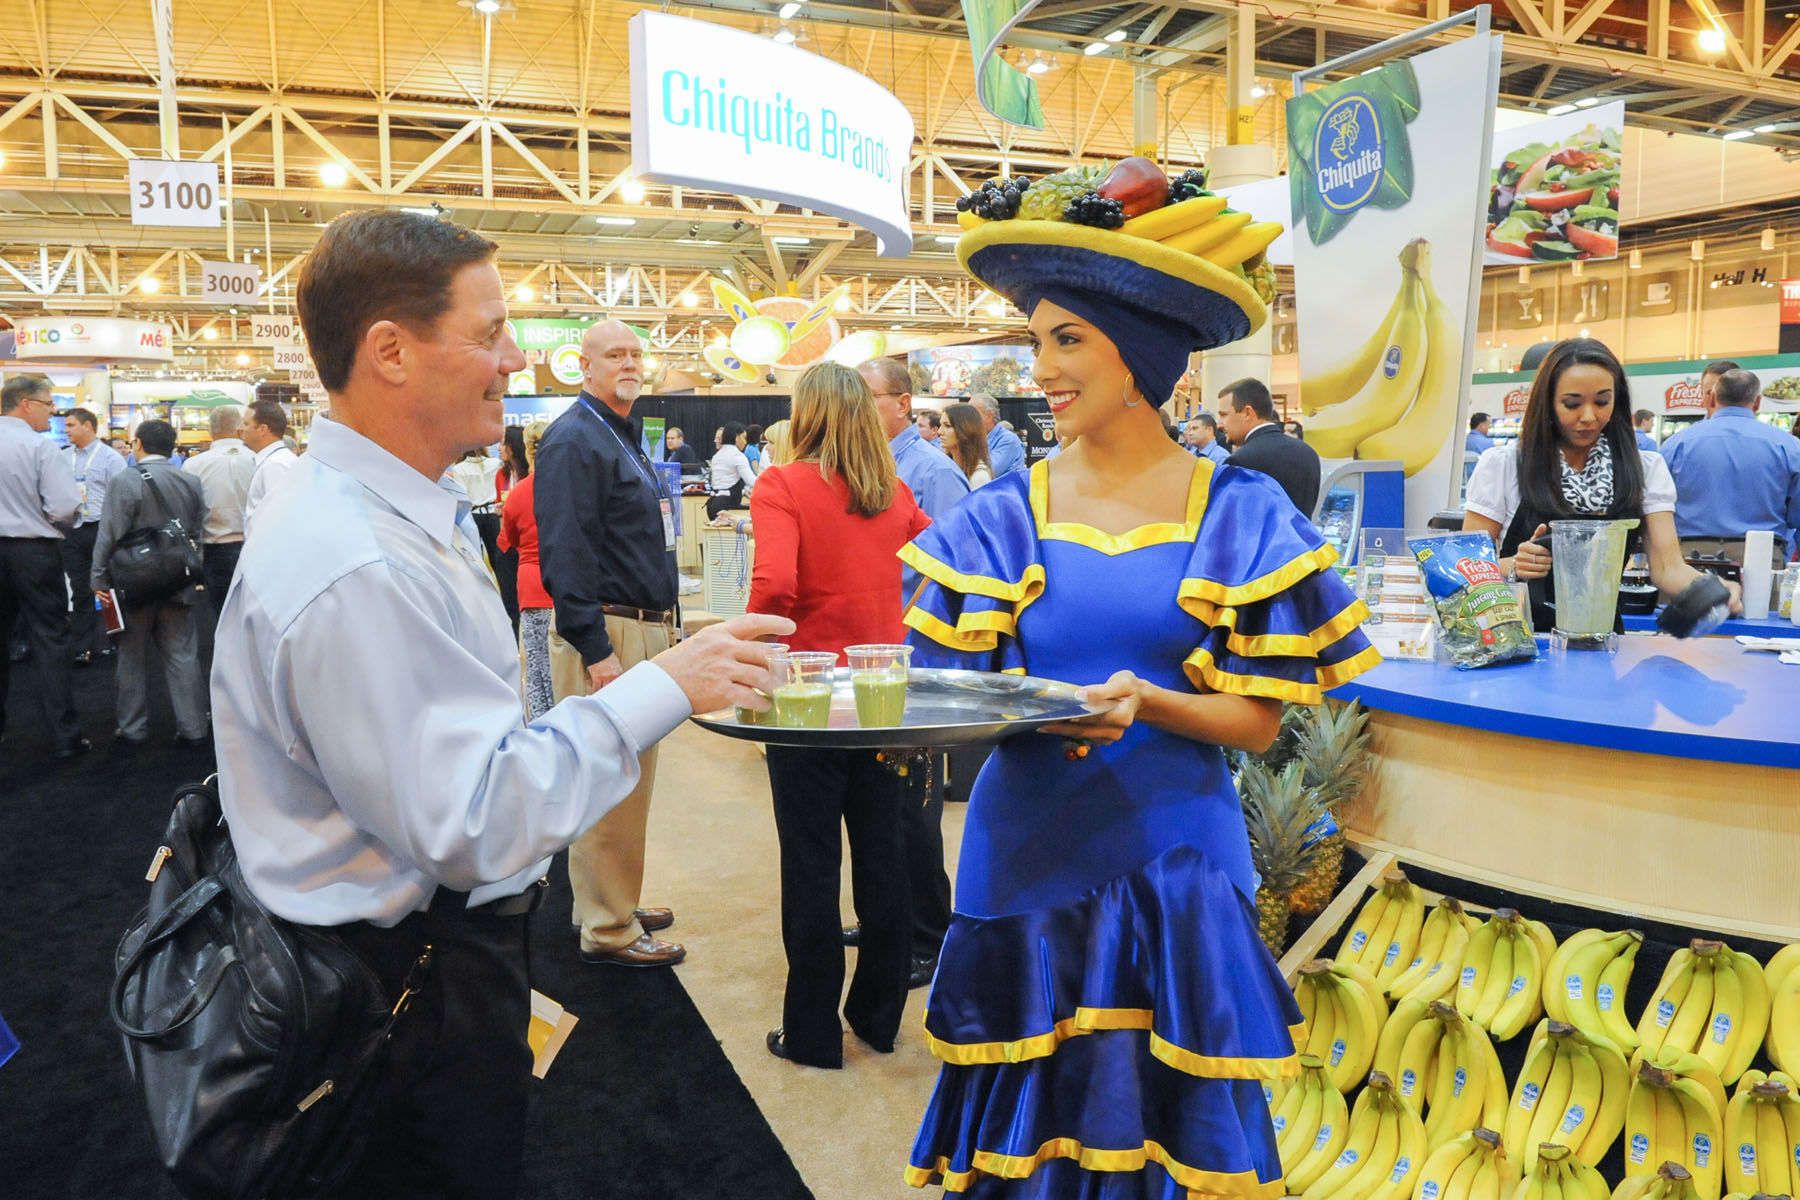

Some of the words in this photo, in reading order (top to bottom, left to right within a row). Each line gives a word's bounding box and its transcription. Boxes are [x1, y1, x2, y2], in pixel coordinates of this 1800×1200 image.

[661, 69, 811, 155] Chiquita
[820, 107, 893, 184] Brands
[1317, 149, 1382, 194] Chiquita
[138, 180, 213, 210] 3100
[1752, 267, 1767, 283] H
[206, 274, 254, 295] 3000
[255, 324, 290, 338] 2900
[277, 352, 304, 364] 2800
[292, 370, 315, 379] 2700
[1670, 382, 1703, 399] Fresh
[1460, 560, 1494, 576] Fresh
